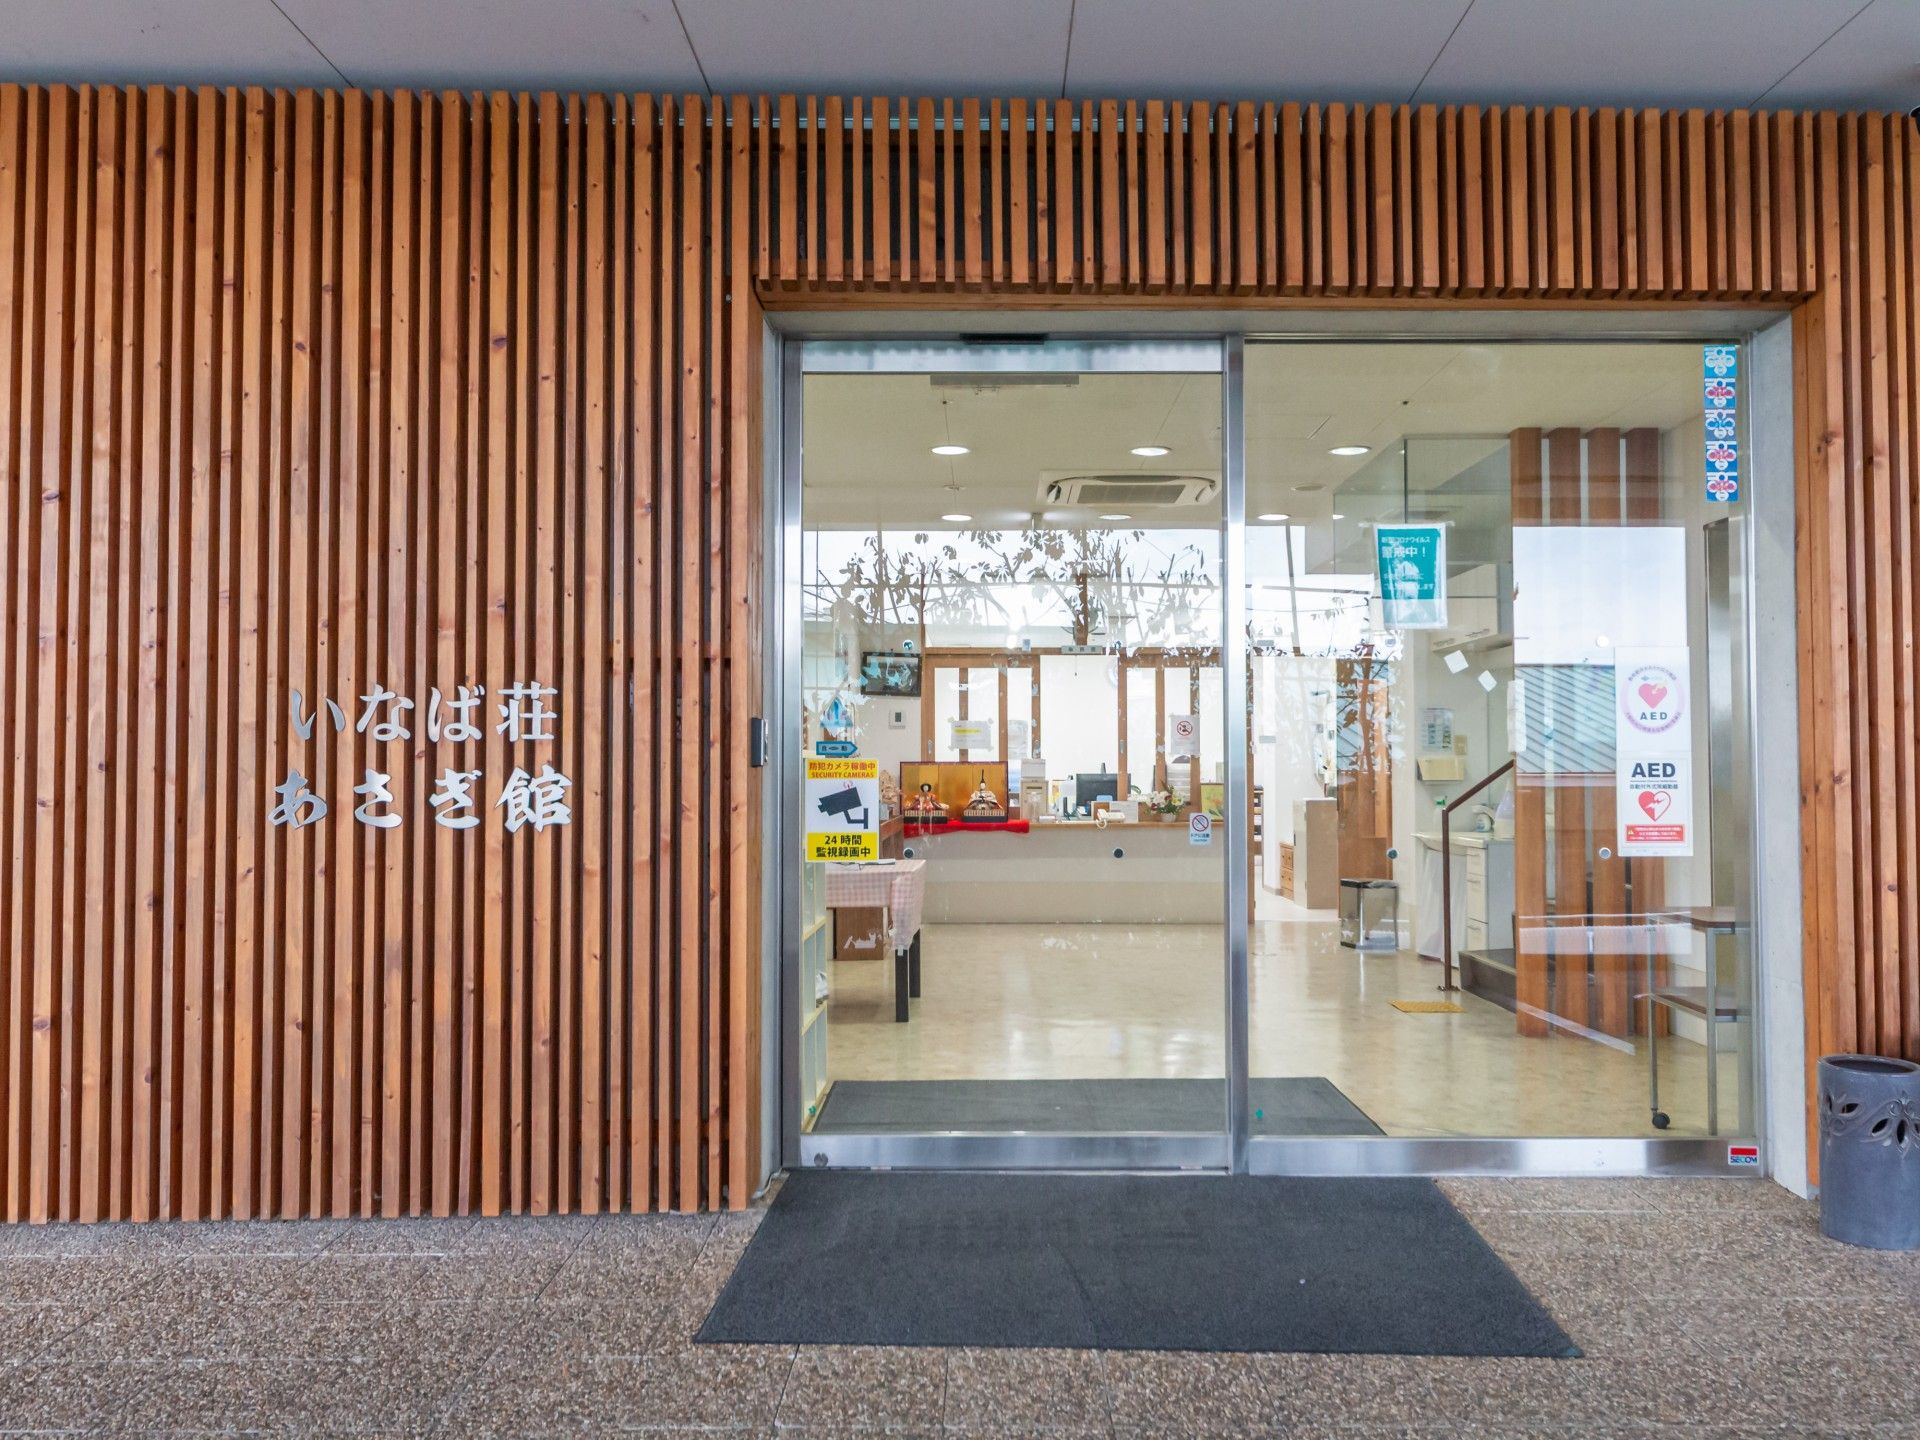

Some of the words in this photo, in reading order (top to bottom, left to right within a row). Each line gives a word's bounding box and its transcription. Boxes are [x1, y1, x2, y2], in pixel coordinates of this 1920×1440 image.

[291, 681, 558, 742] いなば荘
[1640, 711, 1668, 720] AED
[809, 762, 876, 771] 防犯カメラ稼働中
[1631, 762, 1676, 778] AED
[268, 764, 572, 833] あさぎ館
[824, 835, 838, 845] 24
[840, 834, 862, 846] 時間
[816, 847, 871, 858] 監視録画中
